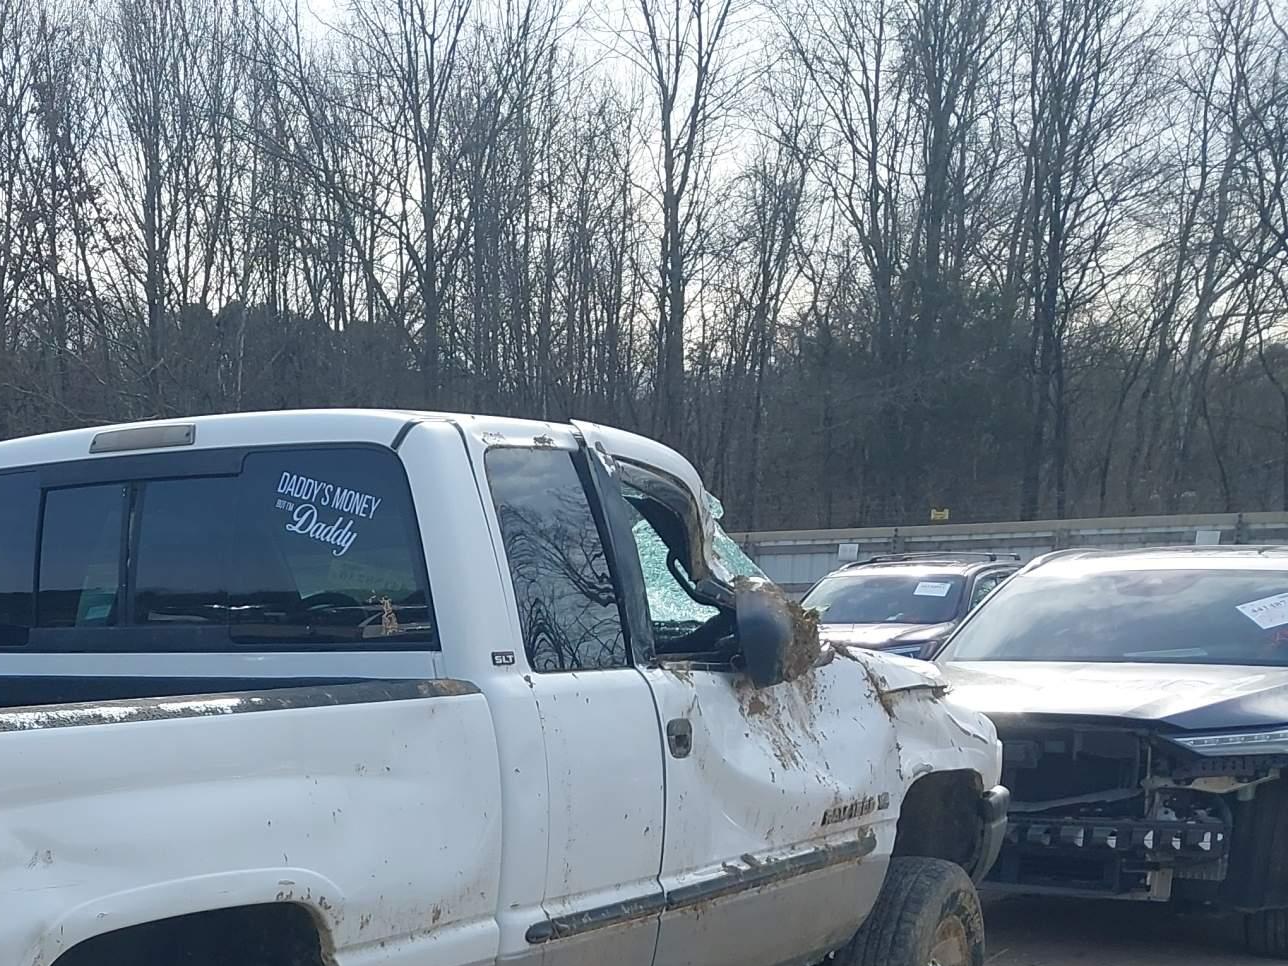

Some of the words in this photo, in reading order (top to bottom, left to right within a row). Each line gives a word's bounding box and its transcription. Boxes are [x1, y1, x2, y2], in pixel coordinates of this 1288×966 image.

[277, 471, 333, 506] DADDY'S
[331, 487, 382, 519] MONEY
[285, 503, 358, 557] Daddy
[494, 655, 514, 664] SLT
